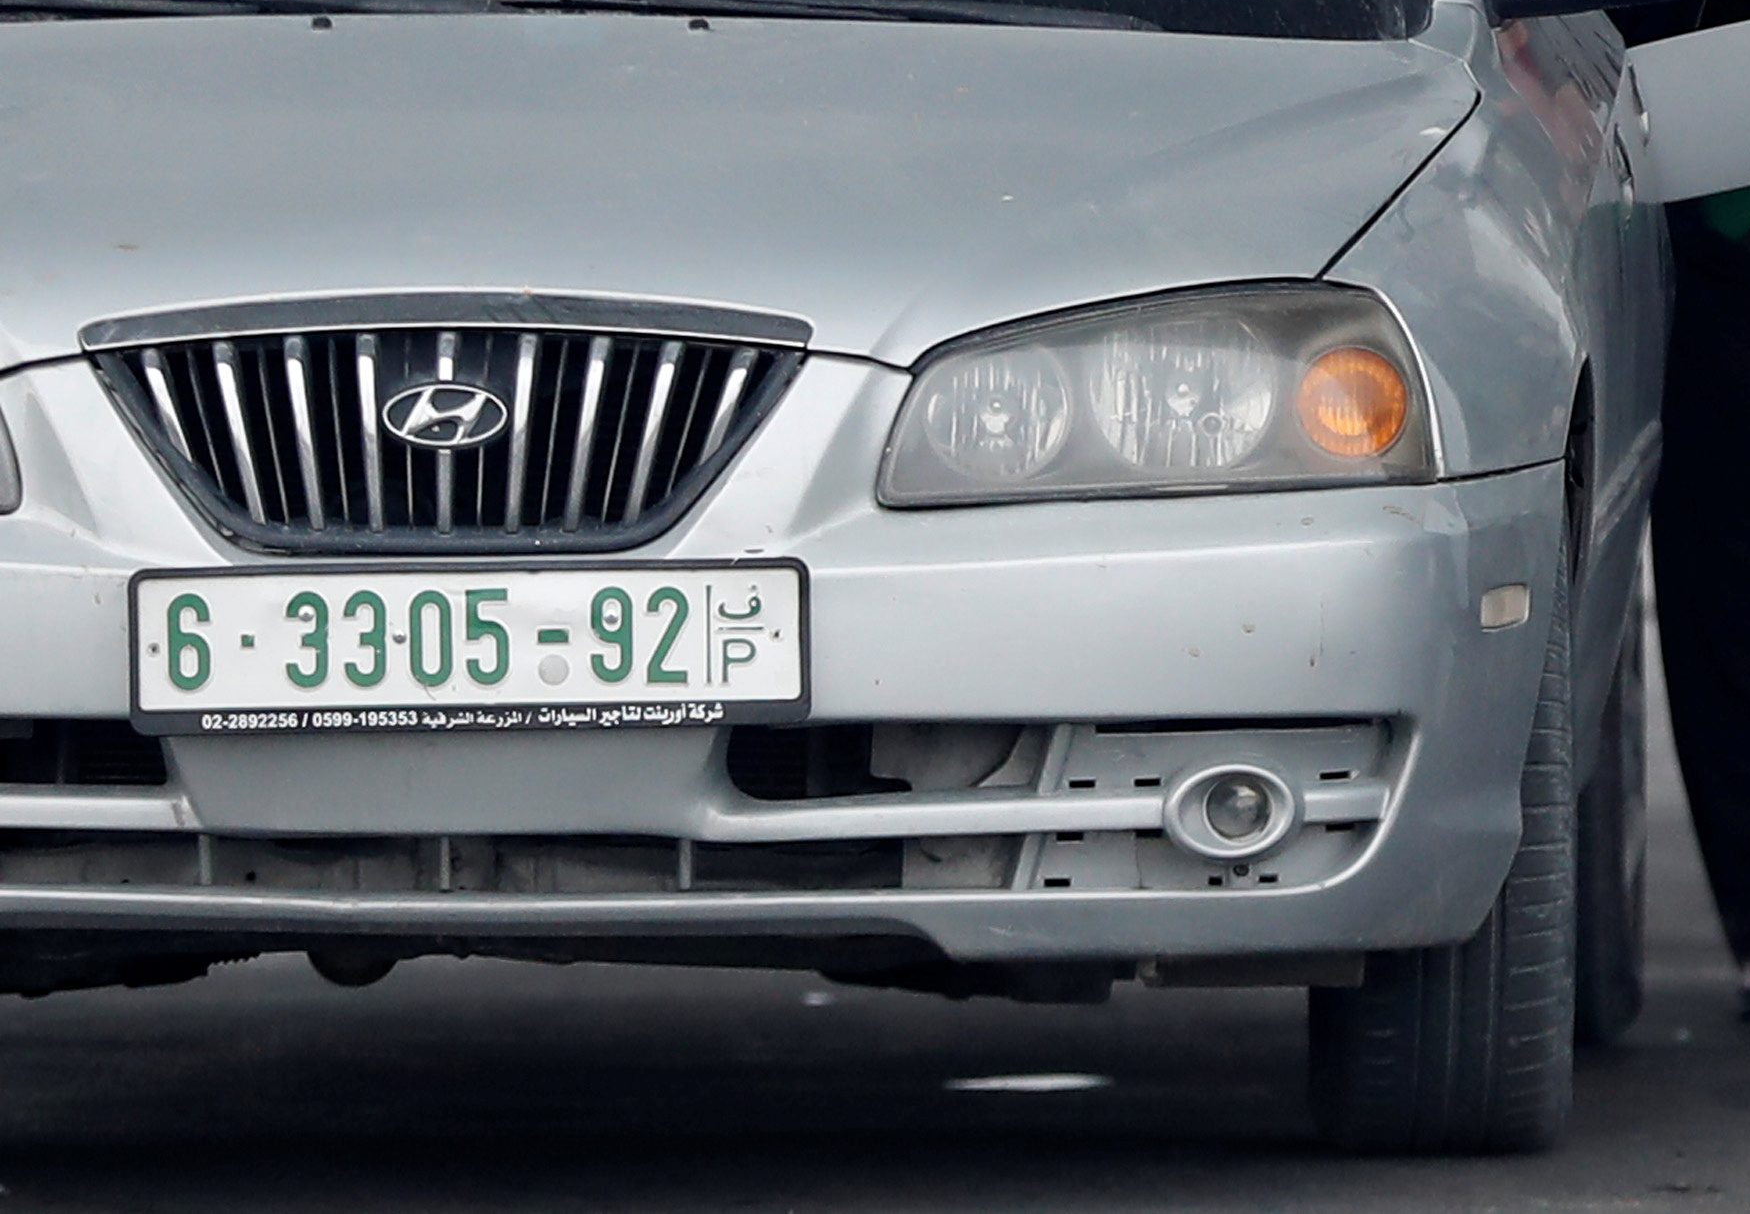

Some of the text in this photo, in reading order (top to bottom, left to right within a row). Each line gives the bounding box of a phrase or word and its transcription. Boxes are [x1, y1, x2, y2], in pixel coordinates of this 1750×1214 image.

[722, 638, 757, 683] P
[201, 713, 298, 730] 02-2892256
[311, 711, 418, 728] 0599-195353
[537, 707, 596, 727] السيارات
[689, 702, 725, 724] شركة
